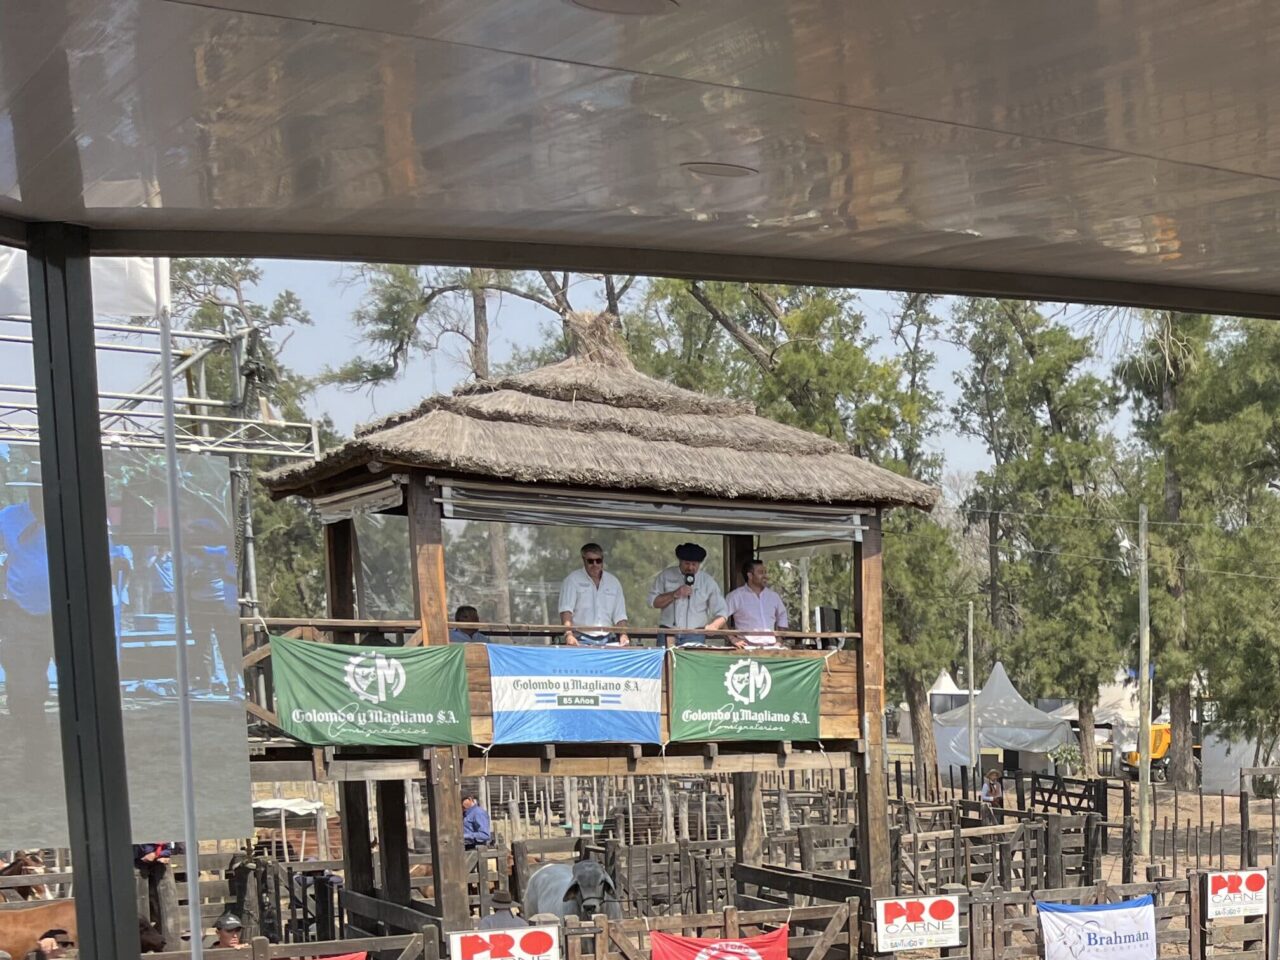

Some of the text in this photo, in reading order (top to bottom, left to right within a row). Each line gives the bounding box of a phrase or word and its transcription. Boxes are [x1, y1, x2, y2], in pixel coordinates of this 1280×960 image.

[512, 679, 561, 691] Colombo
[563, 681, 570, 692] y
[570, 679, 621, 693] Magliano
[292, 708, 460, 727] Colombo y Magliano S.A.
[682, 708, 811, 725] Colombo y Magliano S.A.
[1211, 873, 1265, 896] PRO
[1211, 892, 1264, 904] CARNE
[884, 899, 956, 925] PRO
[886, 920, 954, 934] CARNE
[1087, 930, 1149, 946] Brahman
